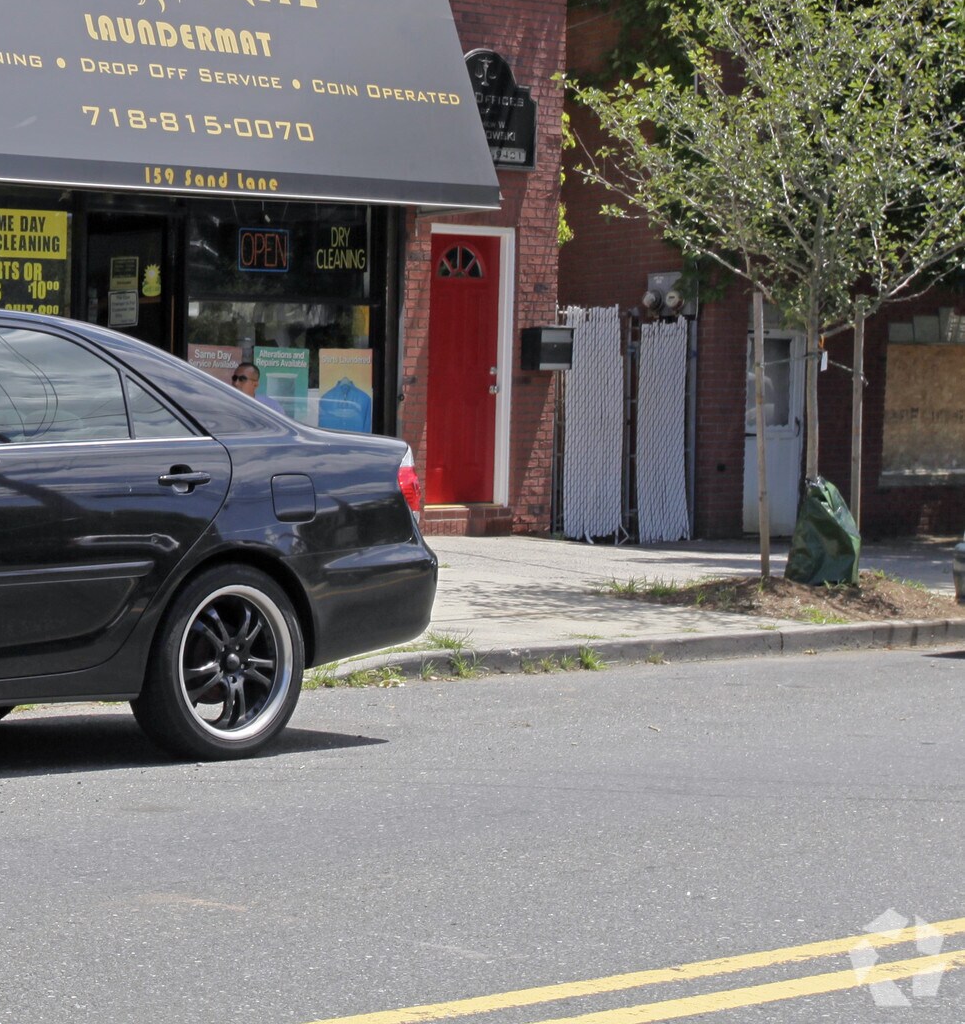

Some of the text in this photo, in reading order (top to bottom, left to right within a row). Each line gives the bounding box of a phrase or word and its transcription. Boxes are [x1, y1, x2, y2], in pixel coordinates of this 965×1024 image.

[84, 13, 272, 57] LAUNDERMAT
[80, 56, 139, 76] DROP
[149, 62, 188, 81] OFF
[199, 68, 282, 90] SERVICE
[313, 79, 359, 97] COIN
[367, 84, 461, 106] OPERATED
[82, 106, 315, 142] 718-815-0070
[485, 130, 516, 142] OWSKI
[144, 167, 279, 192] 159 Sand Lane
[20, 215, 46, 233] DAY
[330, 226, 351, 248] DRY
[240, 232, 287, 268] OPEN
[316, 249, 365, 270] CLEANING
[23, 262, 43, 282] OR
[188, 358, 239, 369] Service Available
[194, 349, 232, 362] Same Day
[256, 358, 307, 368] Repairs Available
[259, 349, 305, 360] Alterations and
